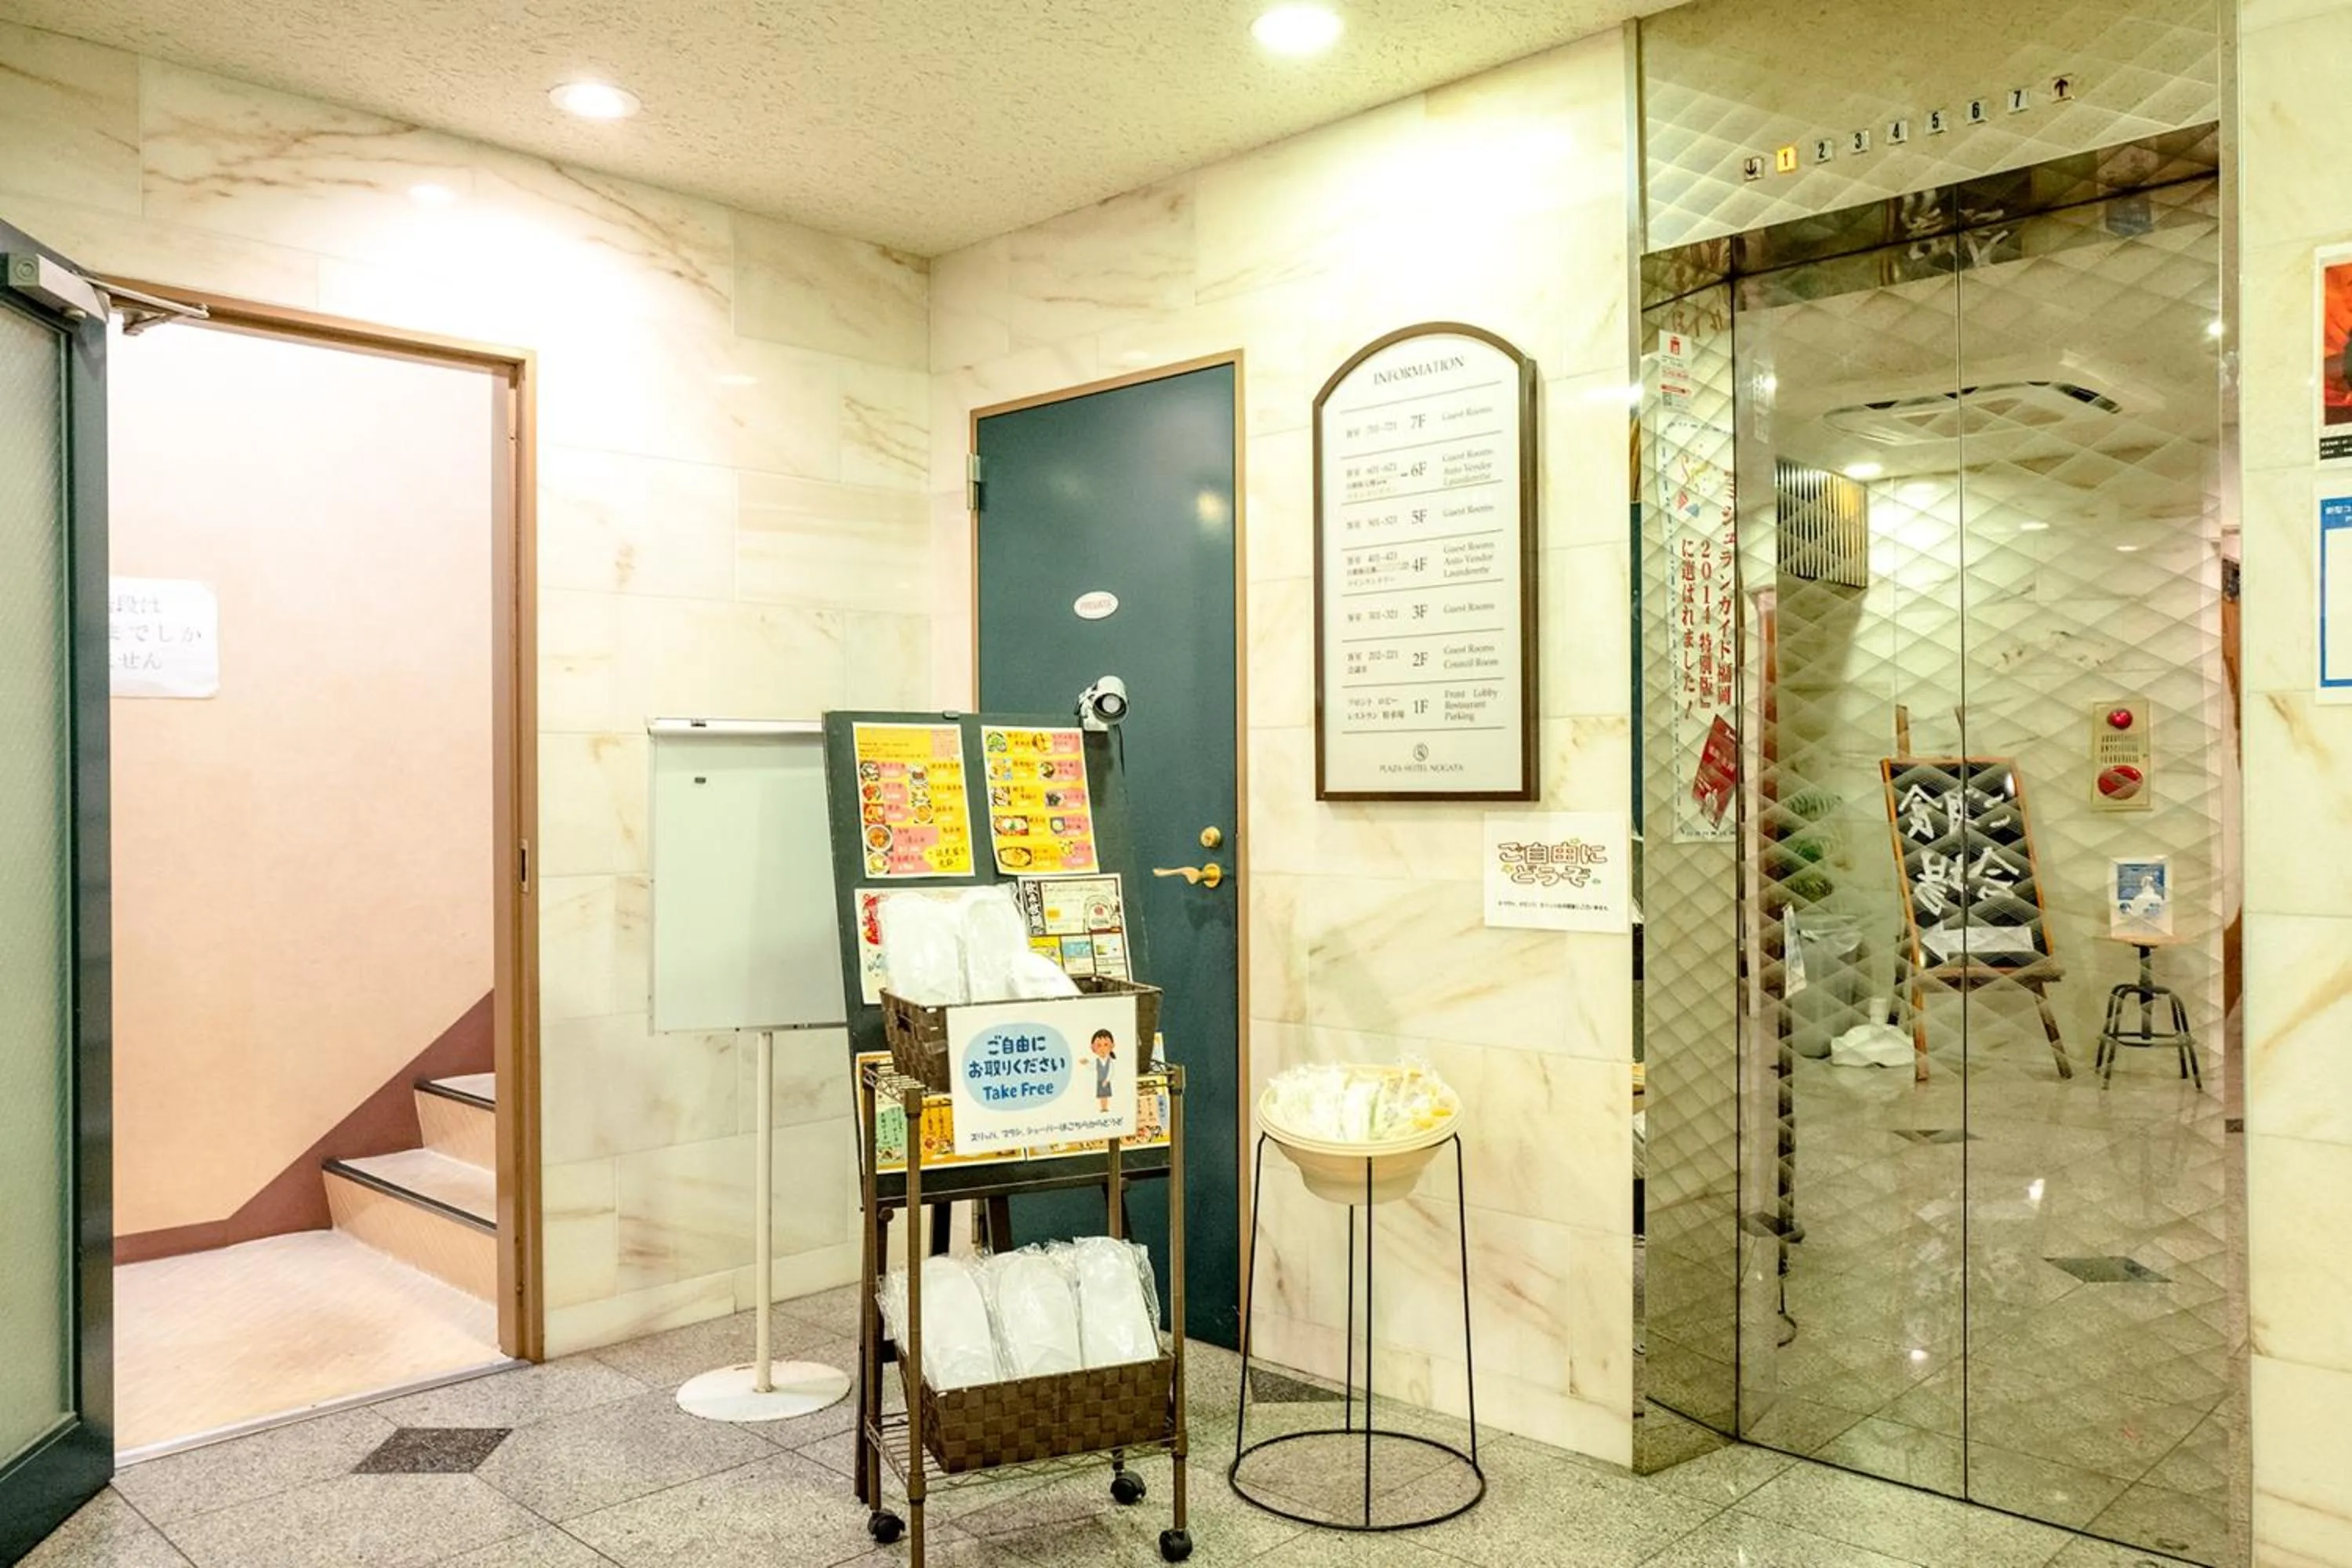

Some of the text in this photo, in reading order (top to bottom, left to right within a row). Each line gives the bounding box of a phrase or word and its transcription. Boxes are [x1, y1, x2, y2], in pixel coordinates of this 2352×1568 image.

[1818, 142, 1826, 159] 2
[1854, 132, 1862, 151] 3
[1891, 122, 1900, 140] 4
[1932, 111, 1940, 129] 5
[1972, 101, 1980, 119] 6
[2013, 90, 2022, 108] 7
[1374, 355, 1465, 386] INFORMATION
[1410, 413, 1427, 430] 7F
[1410, 461, 1427, 478] 6F
[1410, 509, 1428, 526] 5F
[1411, 556, 1428, 572] 4F
[1412, 604, 1428, 620] 3F
[1412, 652, 1428, 668] 2F
[1472, 687, 1499, 699] Lobby
[1412, 699, 1429, 715] 1F
[1444, 711, 1475, 723] Parking
[1379, 764, 1403, 774] PLAZA
[1429, 763, 1465, 774] NOGATA
[1497, 840, 1609, 866] ご自由に
[1510, 865, 1593, 888] どうぞ
[986, 1034, 1047, 1056] ご自由に
[967, 1055, 1067, 1080] お取りください
[982, 1080, 1055, 1102] Take Free
